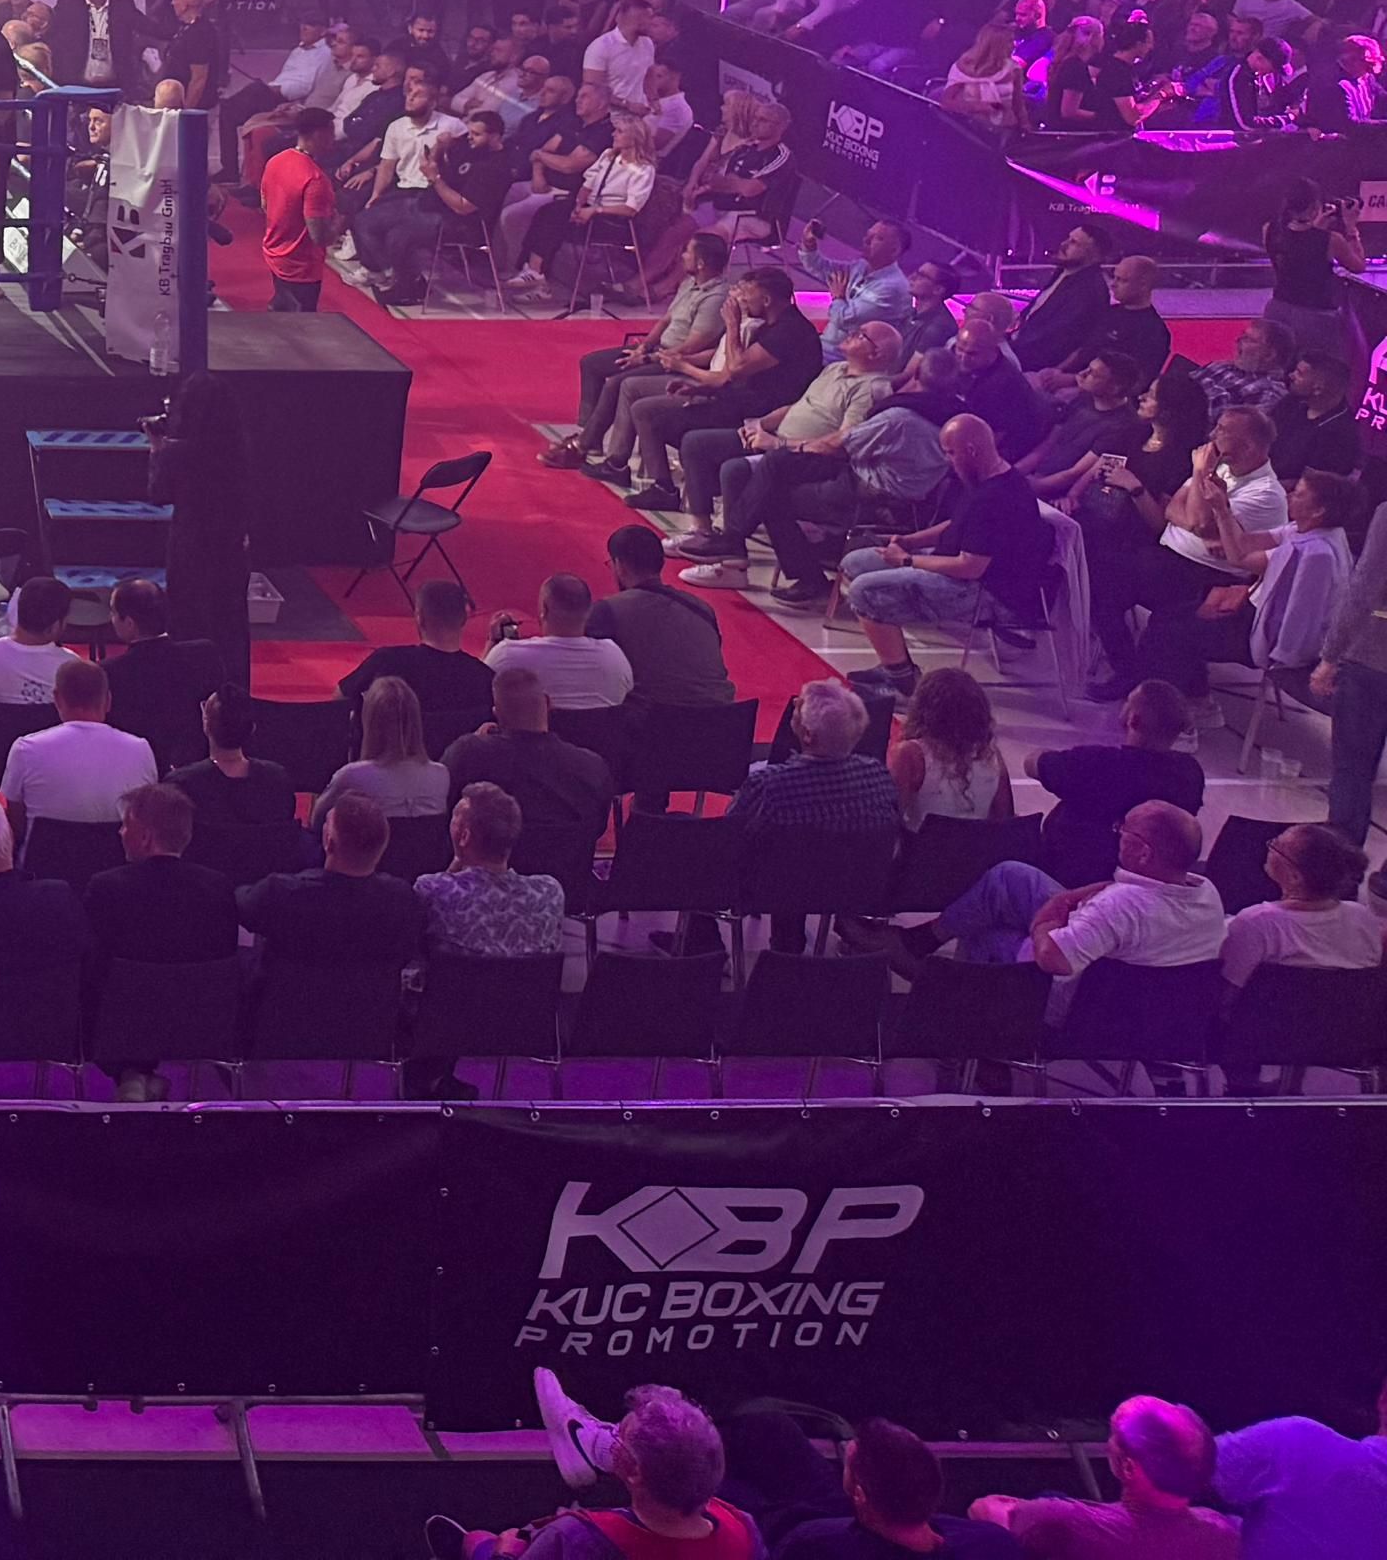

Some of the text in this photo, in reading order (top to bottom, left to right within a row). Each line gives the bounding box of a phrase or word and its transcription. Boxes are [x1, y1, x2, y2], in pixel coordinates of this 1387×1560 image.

[827, 100, 884, 145] KBP
[159, 179, 174, 296] KB Tragbau GmbH
[538, 1180, 925, 1279] KBP
[525, 1281, 885, 1326] KUC BOXING
[513, 1321, 870, 1356] PROMOTION
